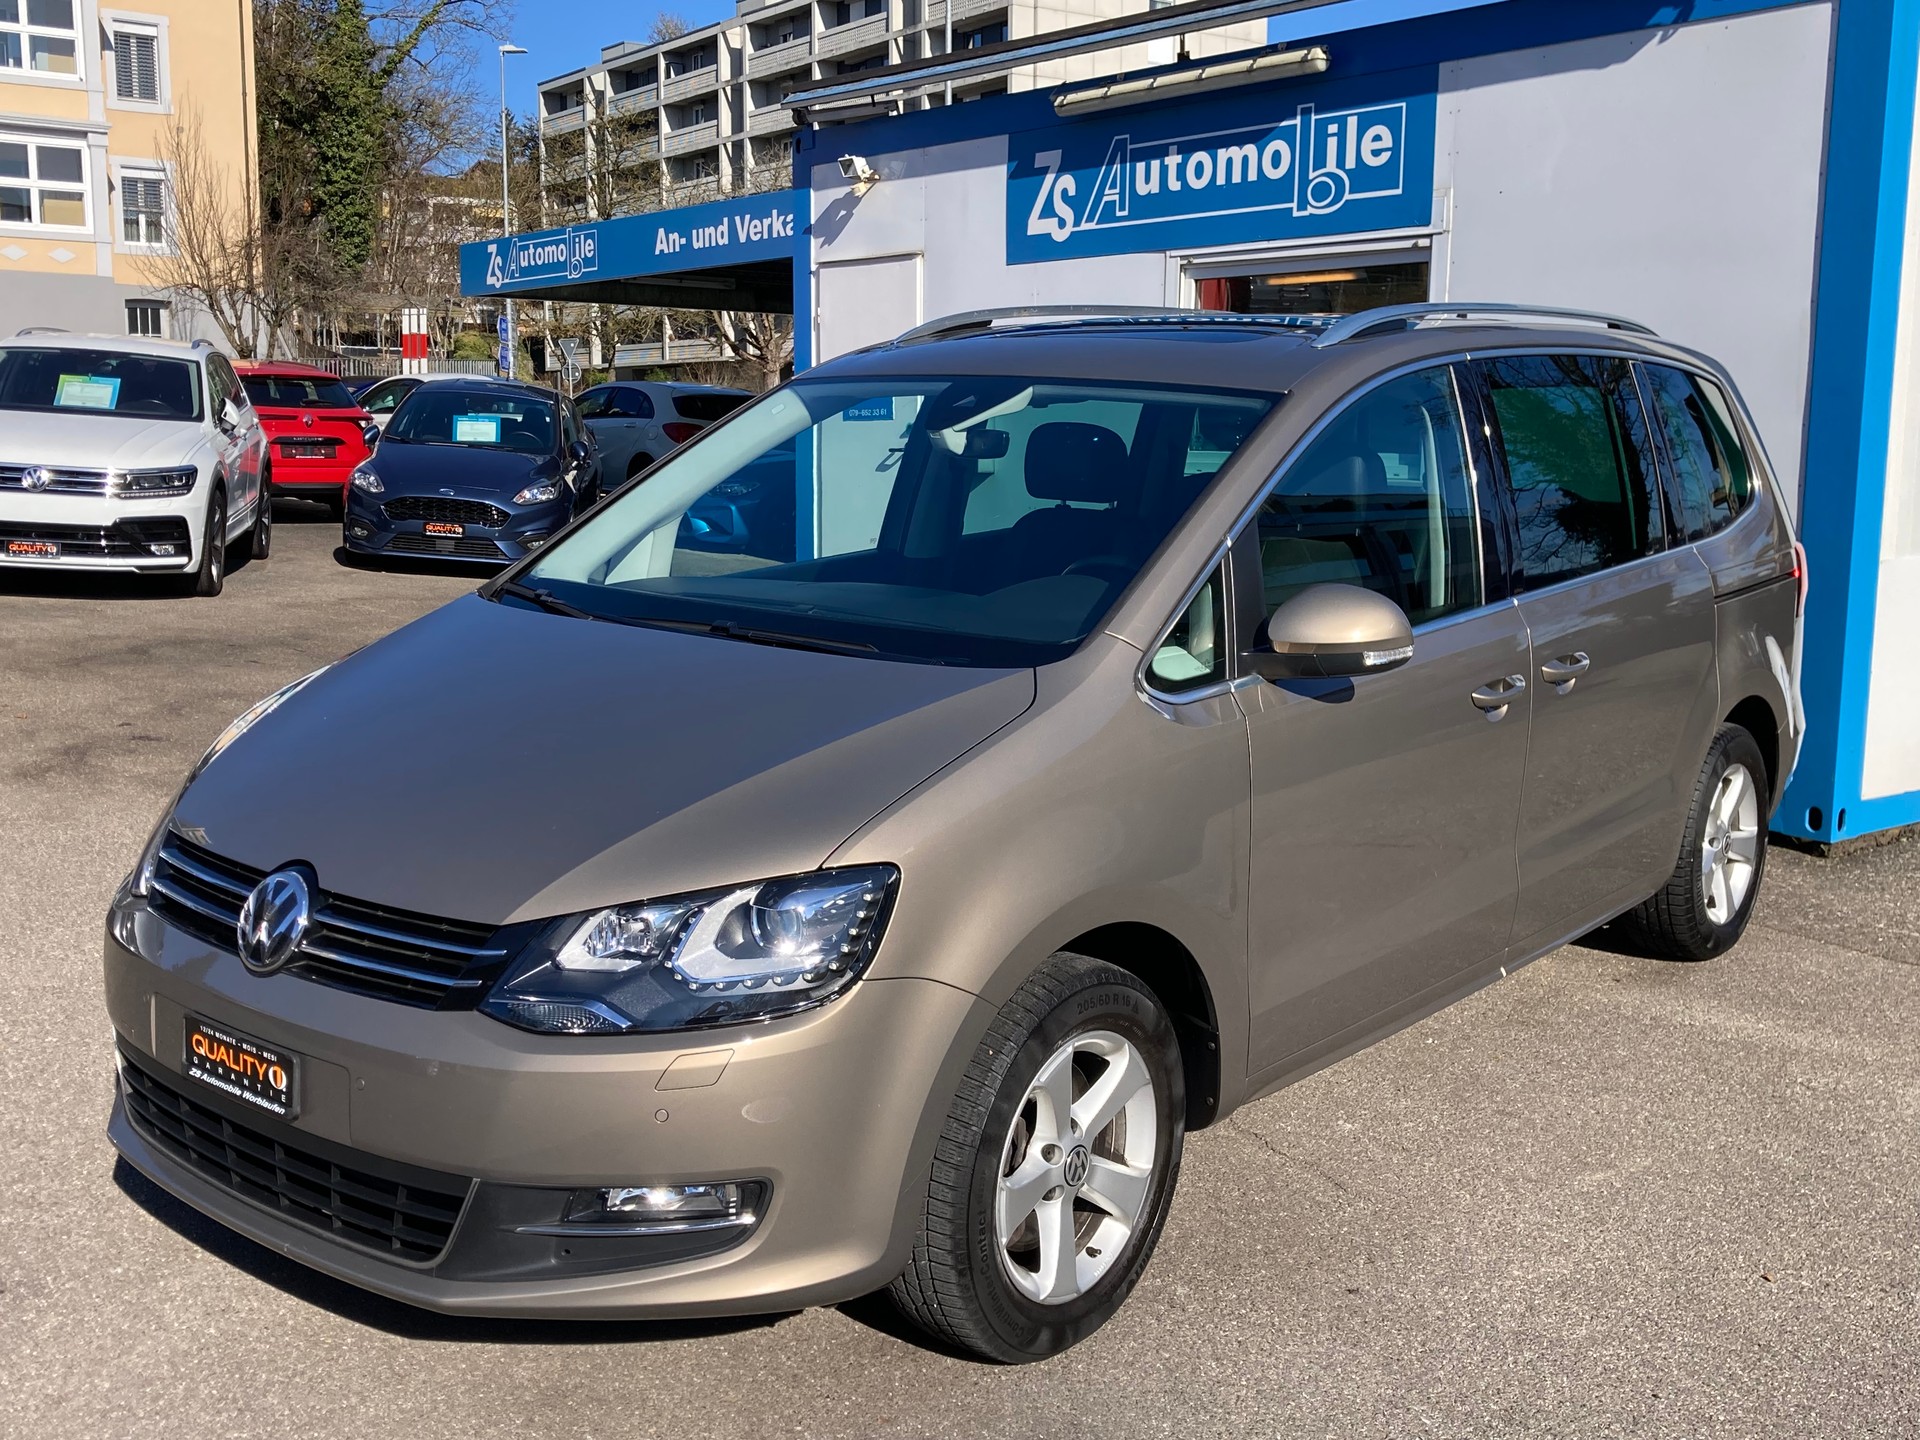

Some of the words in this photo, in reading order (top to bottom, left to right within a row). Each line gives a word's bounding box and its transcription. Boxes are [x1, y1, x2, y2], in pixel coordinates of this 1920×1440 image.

[1080, 103, 1394, 226] Automobile
[504, 228, 595, 281] Automobile
[655, 227, 686, 255] An-
[692, 217, 728, 249] und
[1077, 994, 1111, 1015] 205/60
[1112, 993, 1119, 1006] R
[1122, 995, 1131, 1007] 16
[200, 1025, 214, 1036] 12/24
[215, 1031, 237, 1046] MONATE
[242, 1042, 257, 1054] MOIS
[263, 1051, 277, 1062] MESI
[188, 1067, 202, 1078] ZS
[200, 1073, 242, 1097] Automobile
[242, 1090, 286, 1115] Worblaufen
